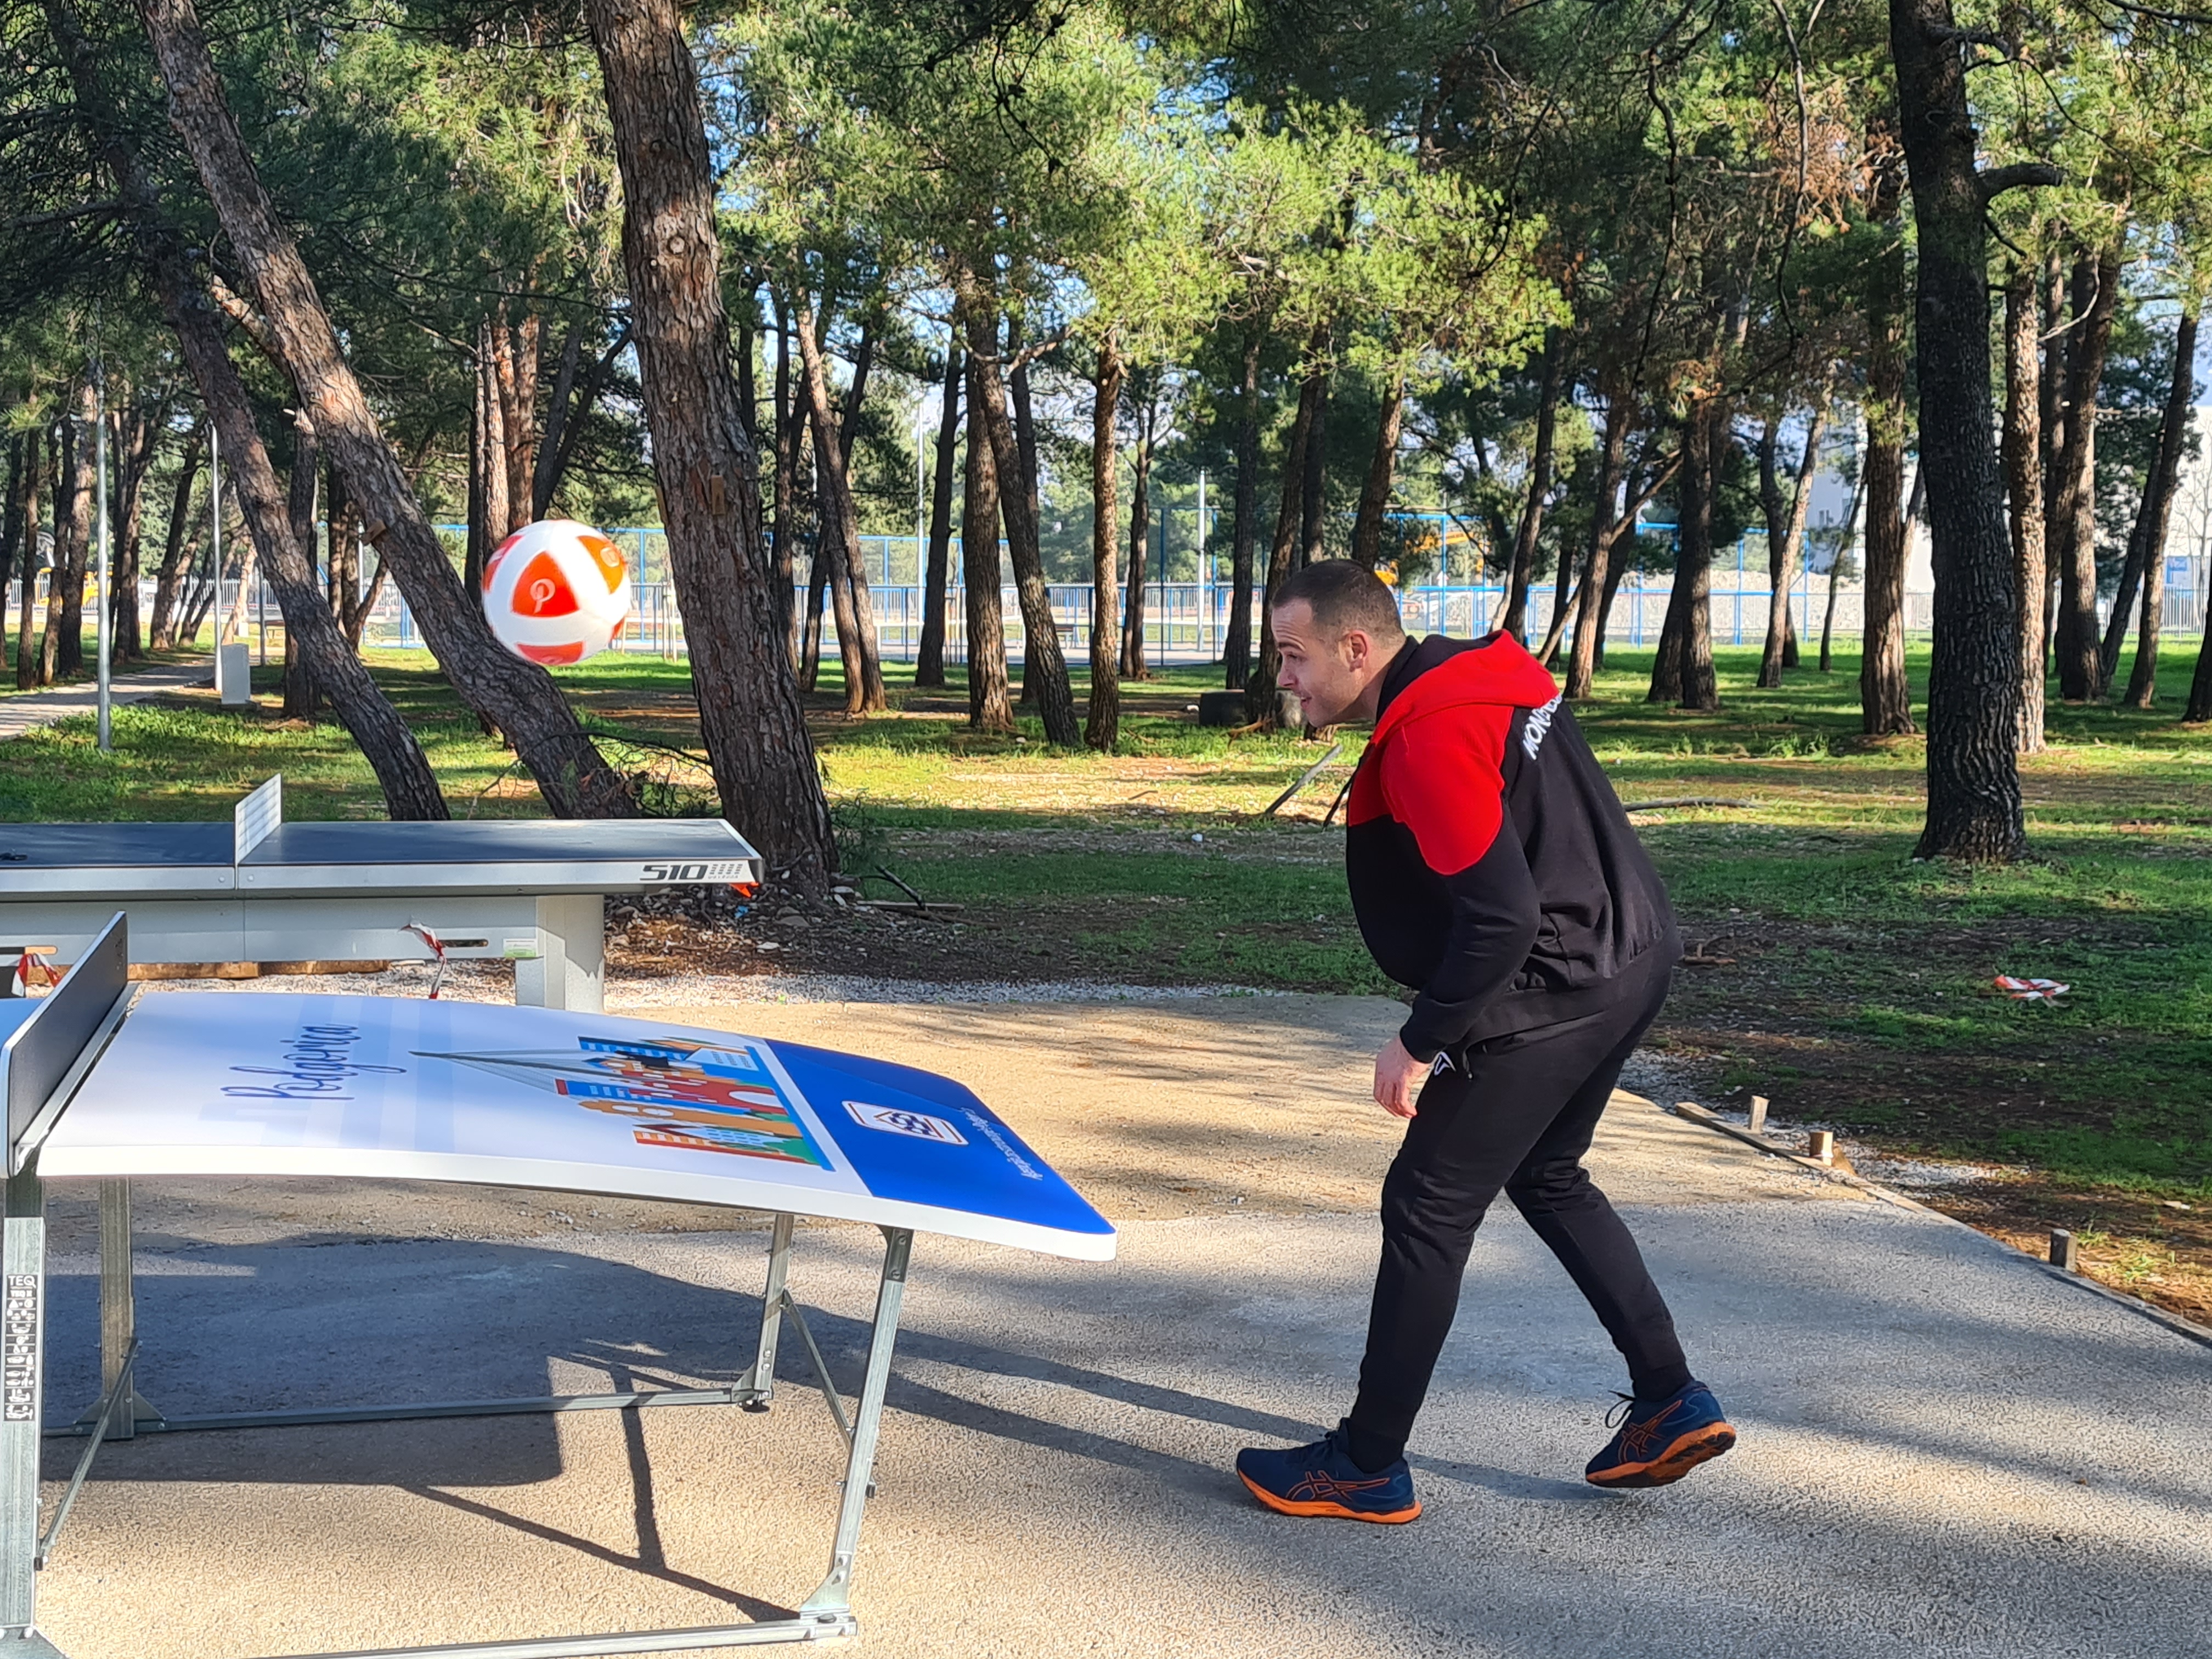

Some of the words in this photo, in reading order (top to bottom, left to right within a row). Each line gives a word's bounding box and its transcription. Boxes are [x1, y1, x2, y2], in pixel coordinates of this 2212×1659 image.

[639, 864, 709, 881] 510
[220, 1023, 407, 1100] Podgorica
[8, 1275, 37, 1289] TEQ
